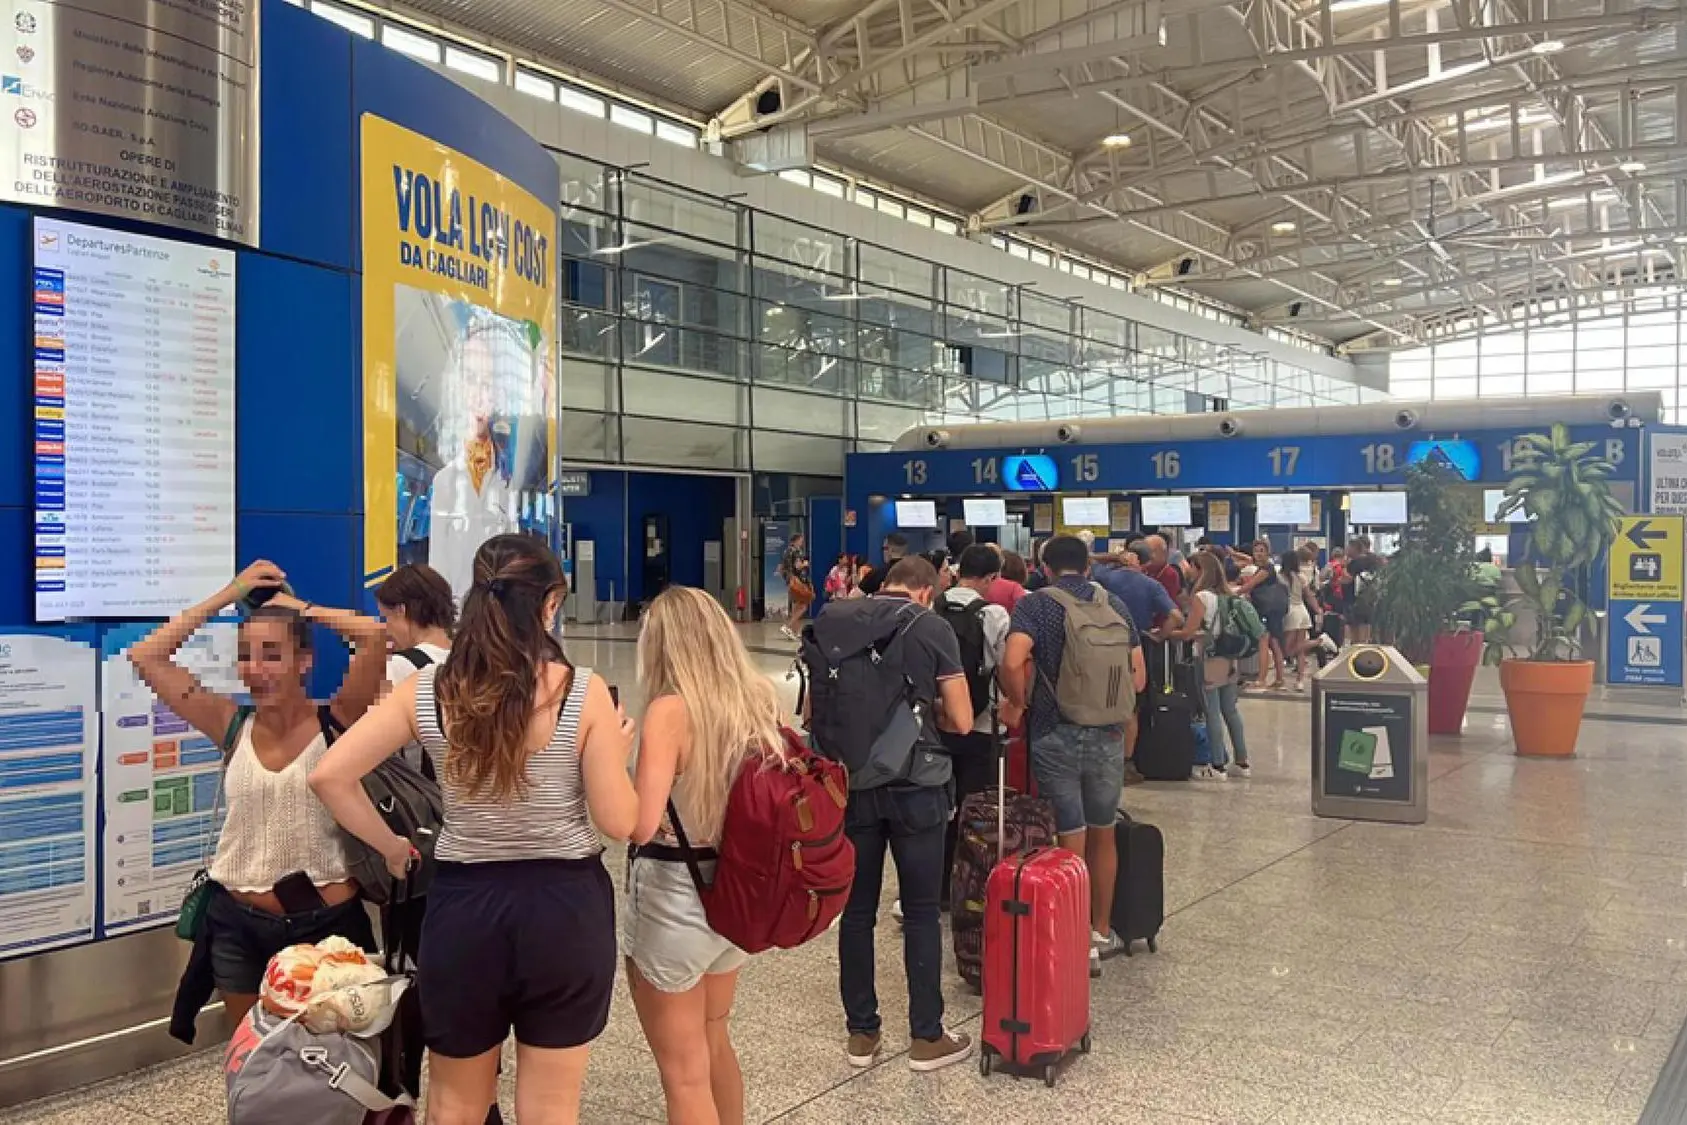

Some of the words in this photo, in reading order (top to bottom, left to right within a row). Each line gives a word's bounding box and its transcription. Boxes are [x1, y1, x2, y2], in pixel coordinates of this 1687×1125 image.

[120, 149, 161, 169] OPERE
[164, 159, 176, 173] DI
[24, 153, 157, 187] RISTRUTTURAZIONE
[160, 177, 168, 189] E
[171, 181, 240, 208] AMPLIAMENTO
[143, 202, 155, 215] DI
[393, 164, 464, 251] VOLA
[469, 196, 510, 270] LOW
[513, 219, 548, 290] COST
[400, 241, 424, 270] DA
[426, 248, 488, 289] CAGLIARI
[1151, 450, 1181, 479] 16
[1267, 446, 1301, 477] 17
[1363, 441, 1395, 474] 18
[1605, 438, 1625, 466] B
[903, 459, 928, 486] 13
[971, 456, 999, 485] 14
[1071, 453, 1100, 482] 15
